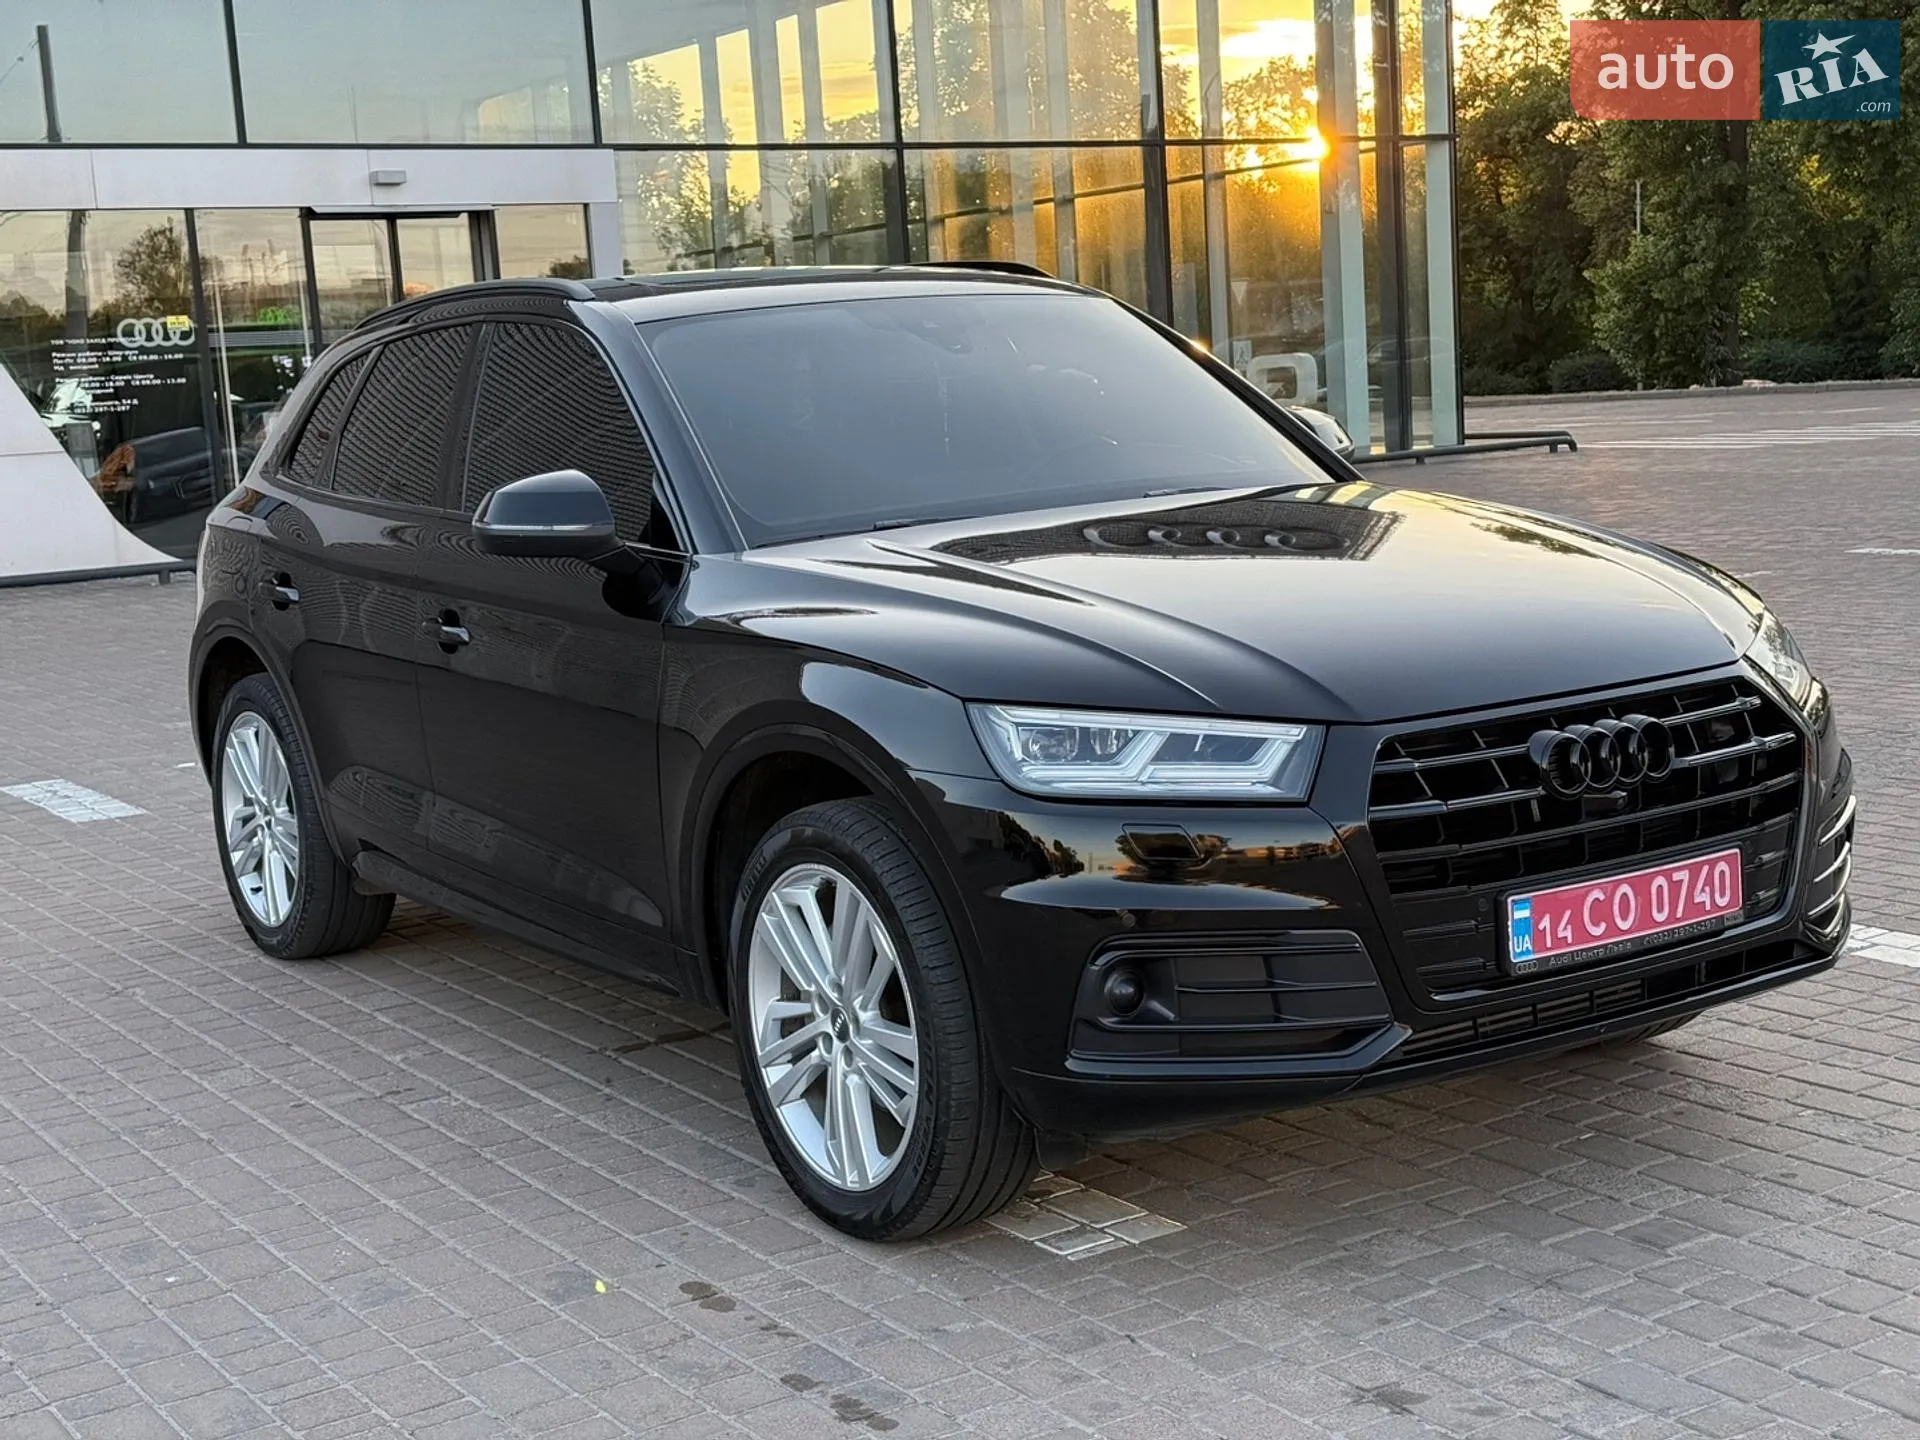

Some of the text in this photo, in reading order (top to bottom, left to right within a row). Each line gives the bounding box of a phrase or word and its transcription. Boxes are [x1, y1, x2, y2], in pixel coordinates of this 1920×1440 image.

[1538, 861, 1731, 948] 14 CO 0740
[1514, 936, 1532, 953] UA
